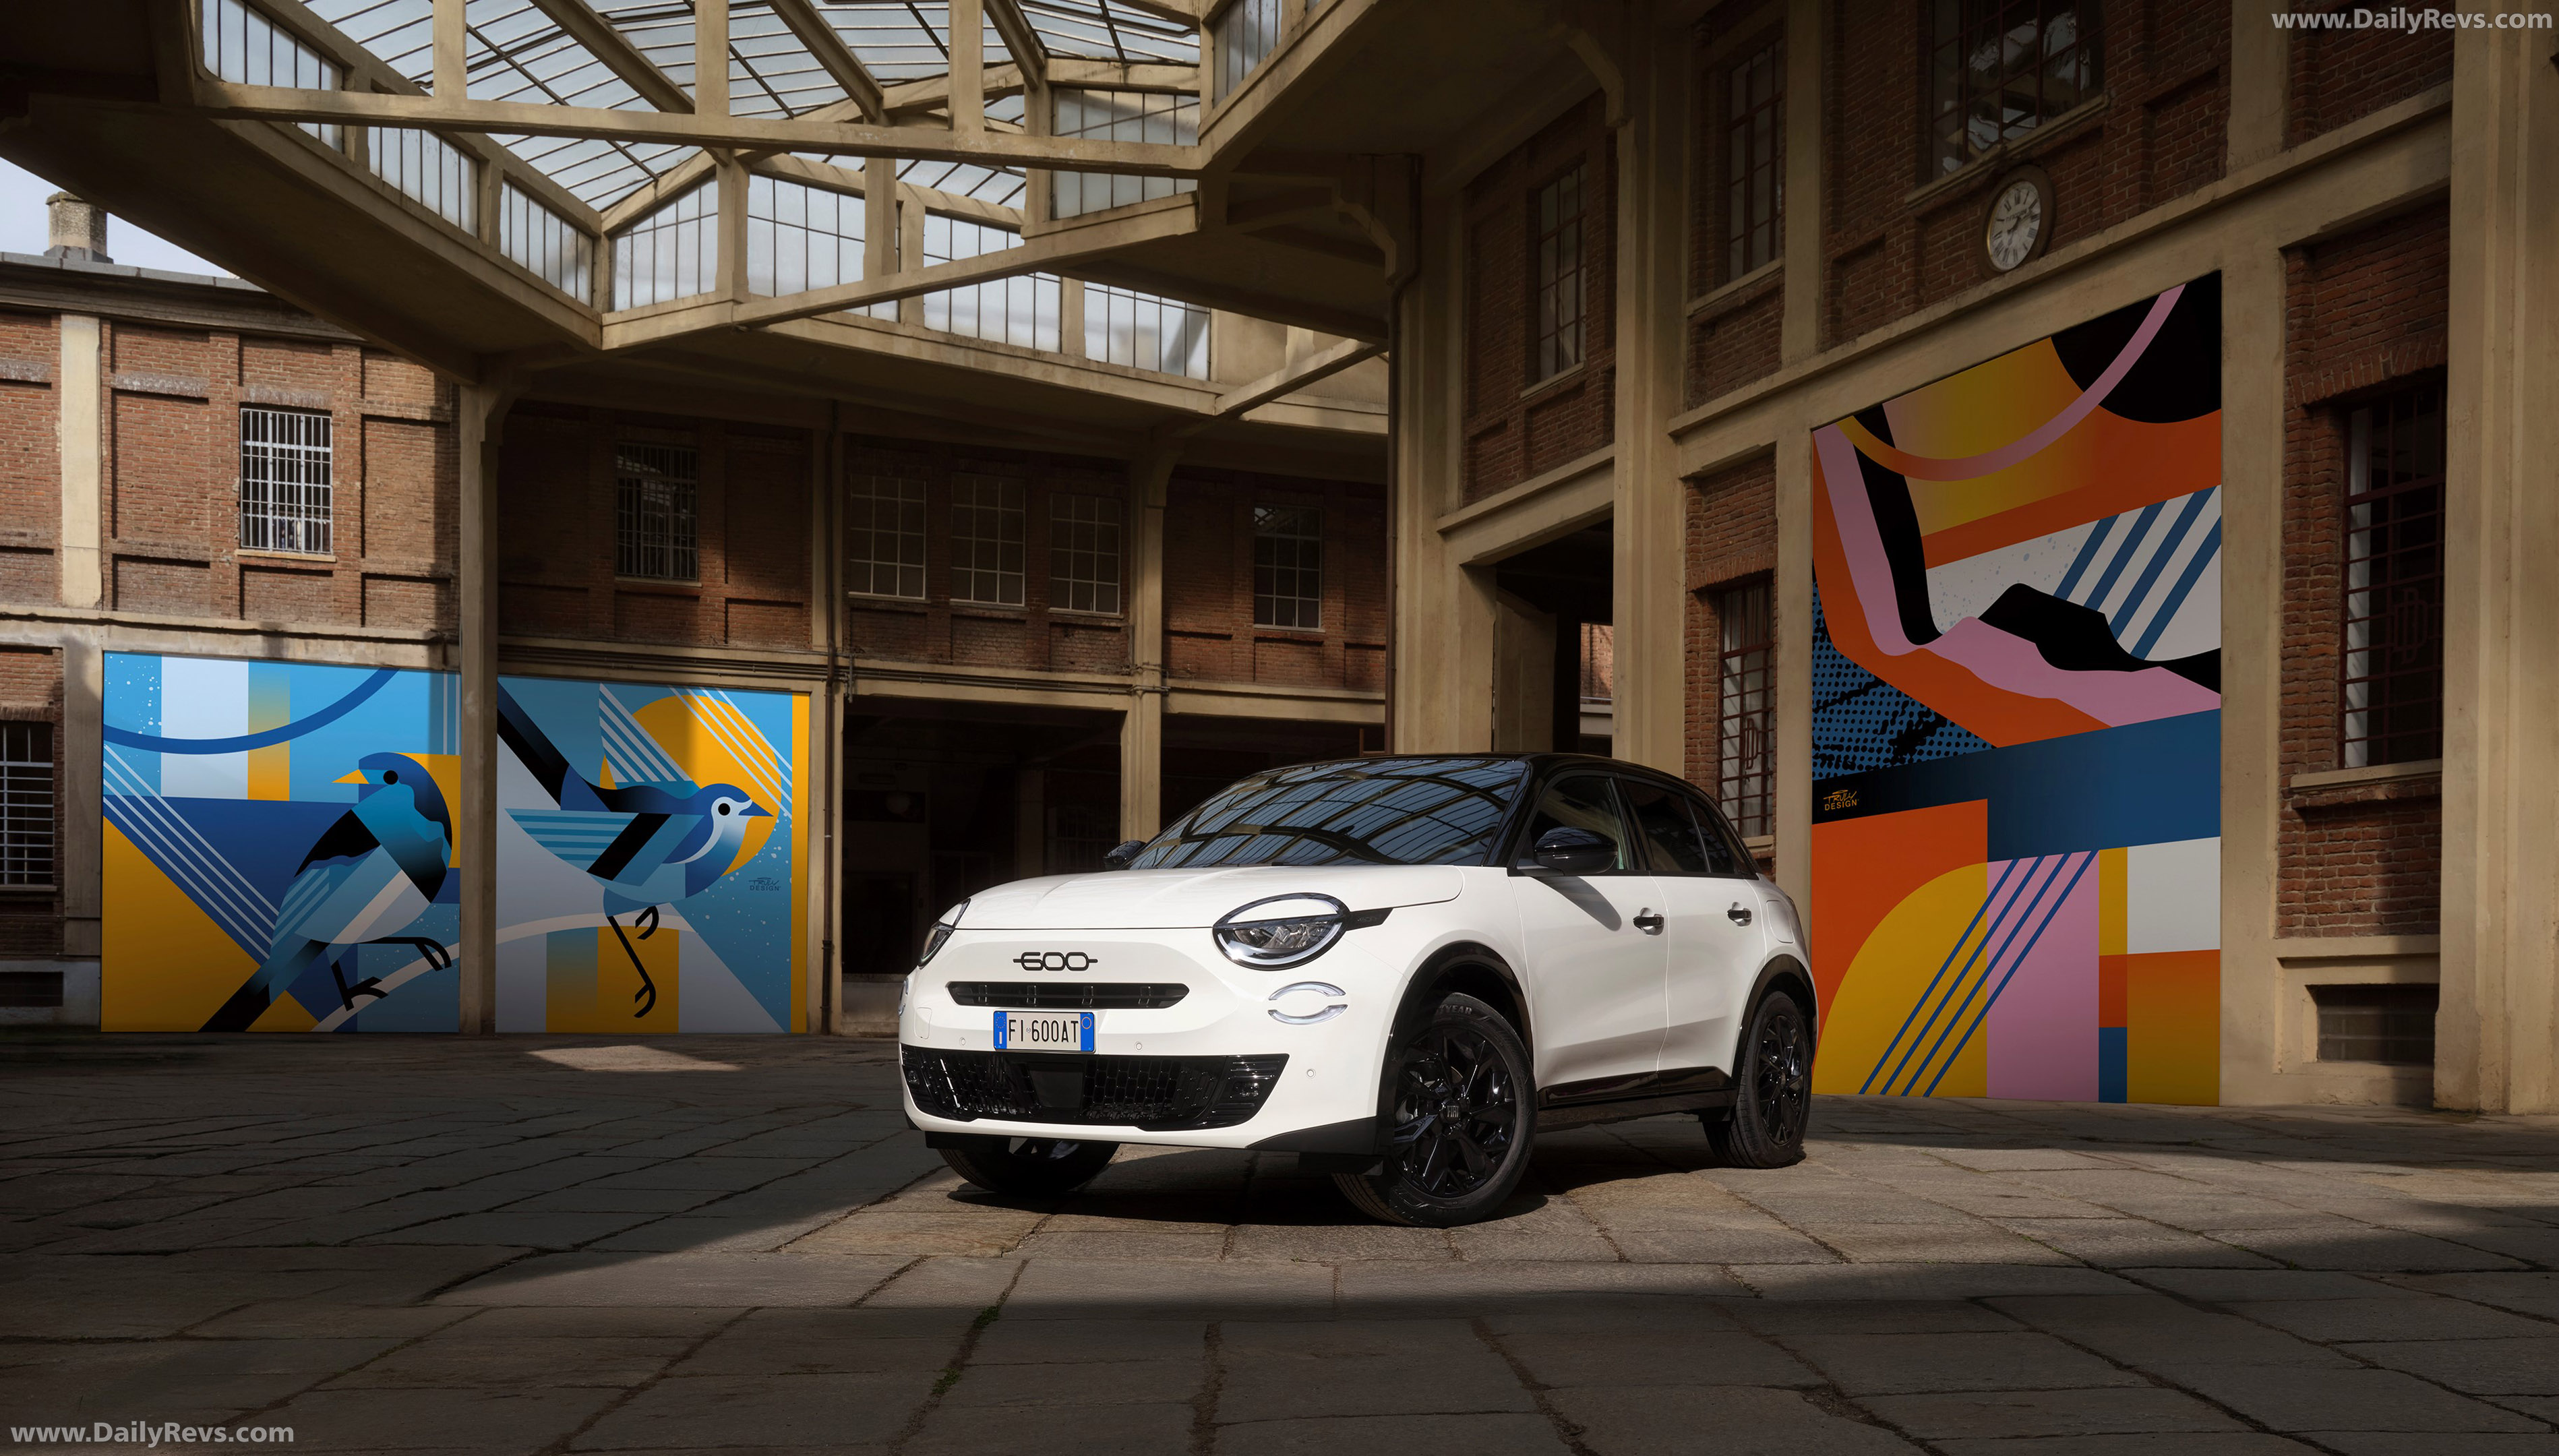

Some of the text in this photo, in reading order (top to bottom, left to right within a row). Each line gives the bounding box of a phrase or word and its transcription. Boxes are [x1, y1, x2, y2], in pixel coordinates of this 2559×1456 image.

[1825, 799, 1857, 811] DESIGN
[1014, 952, 1097, 971] 600
[1447, 1105, 1459, 1118] FIAT
